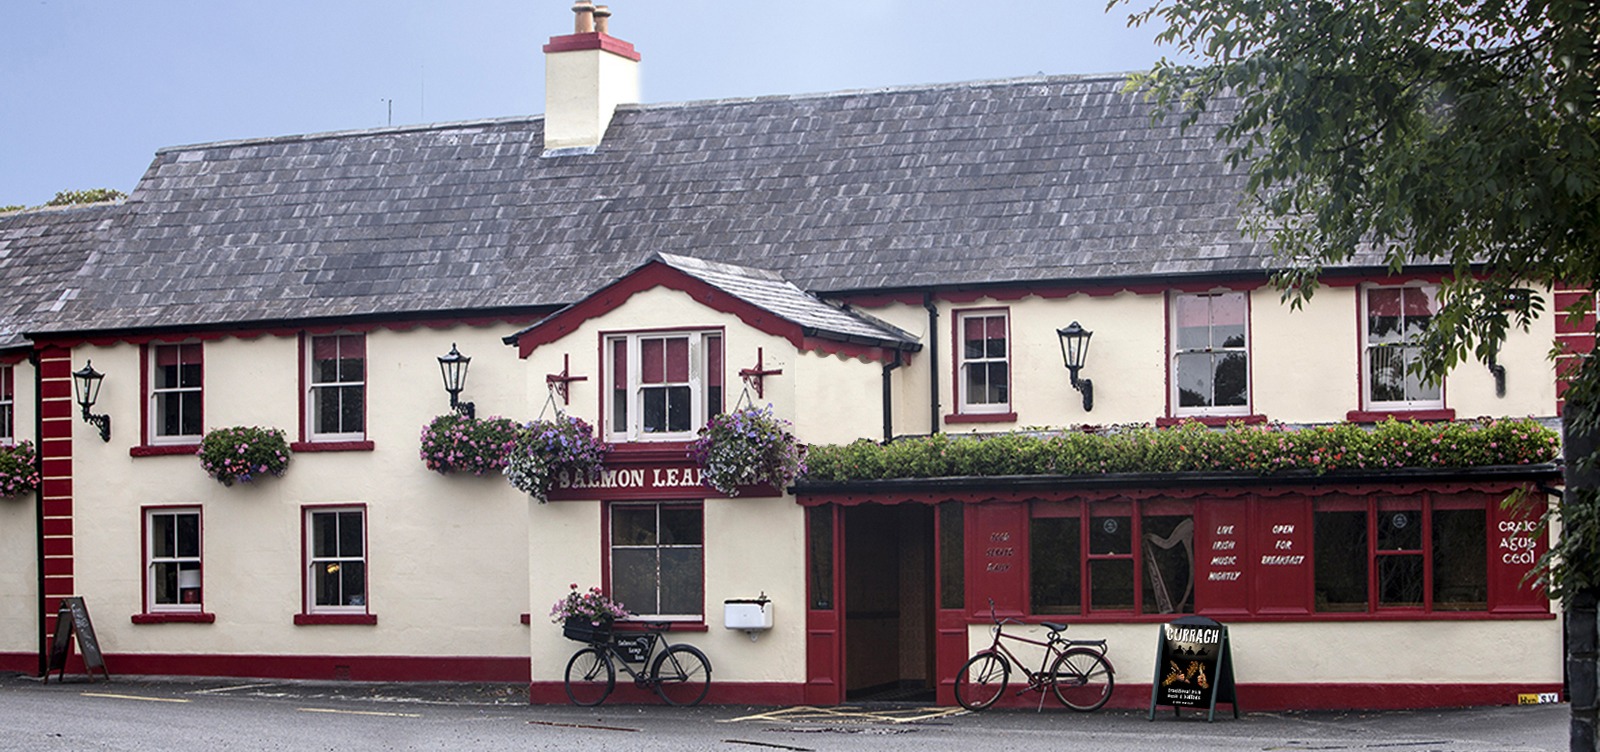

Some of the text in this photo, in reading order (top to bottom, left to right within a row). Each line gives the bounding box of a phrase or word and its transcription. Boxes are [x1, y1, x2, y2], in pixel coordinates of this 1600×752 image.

[1216, 525, 1234, 535] LIVE
[1272, 525, 1294, 534] OPEN
[1212, 541, 1236, 550] IRISH
[1275, 540, 1292, 550] FOR
[1210, 556, 1237, 566] MUSIC
[1261, 555, 1305, 565] BREAKFAST
[1207, 571, 1241, 581] NIGHTLY
[1166, 627, 1220, 644] CURRAGH
